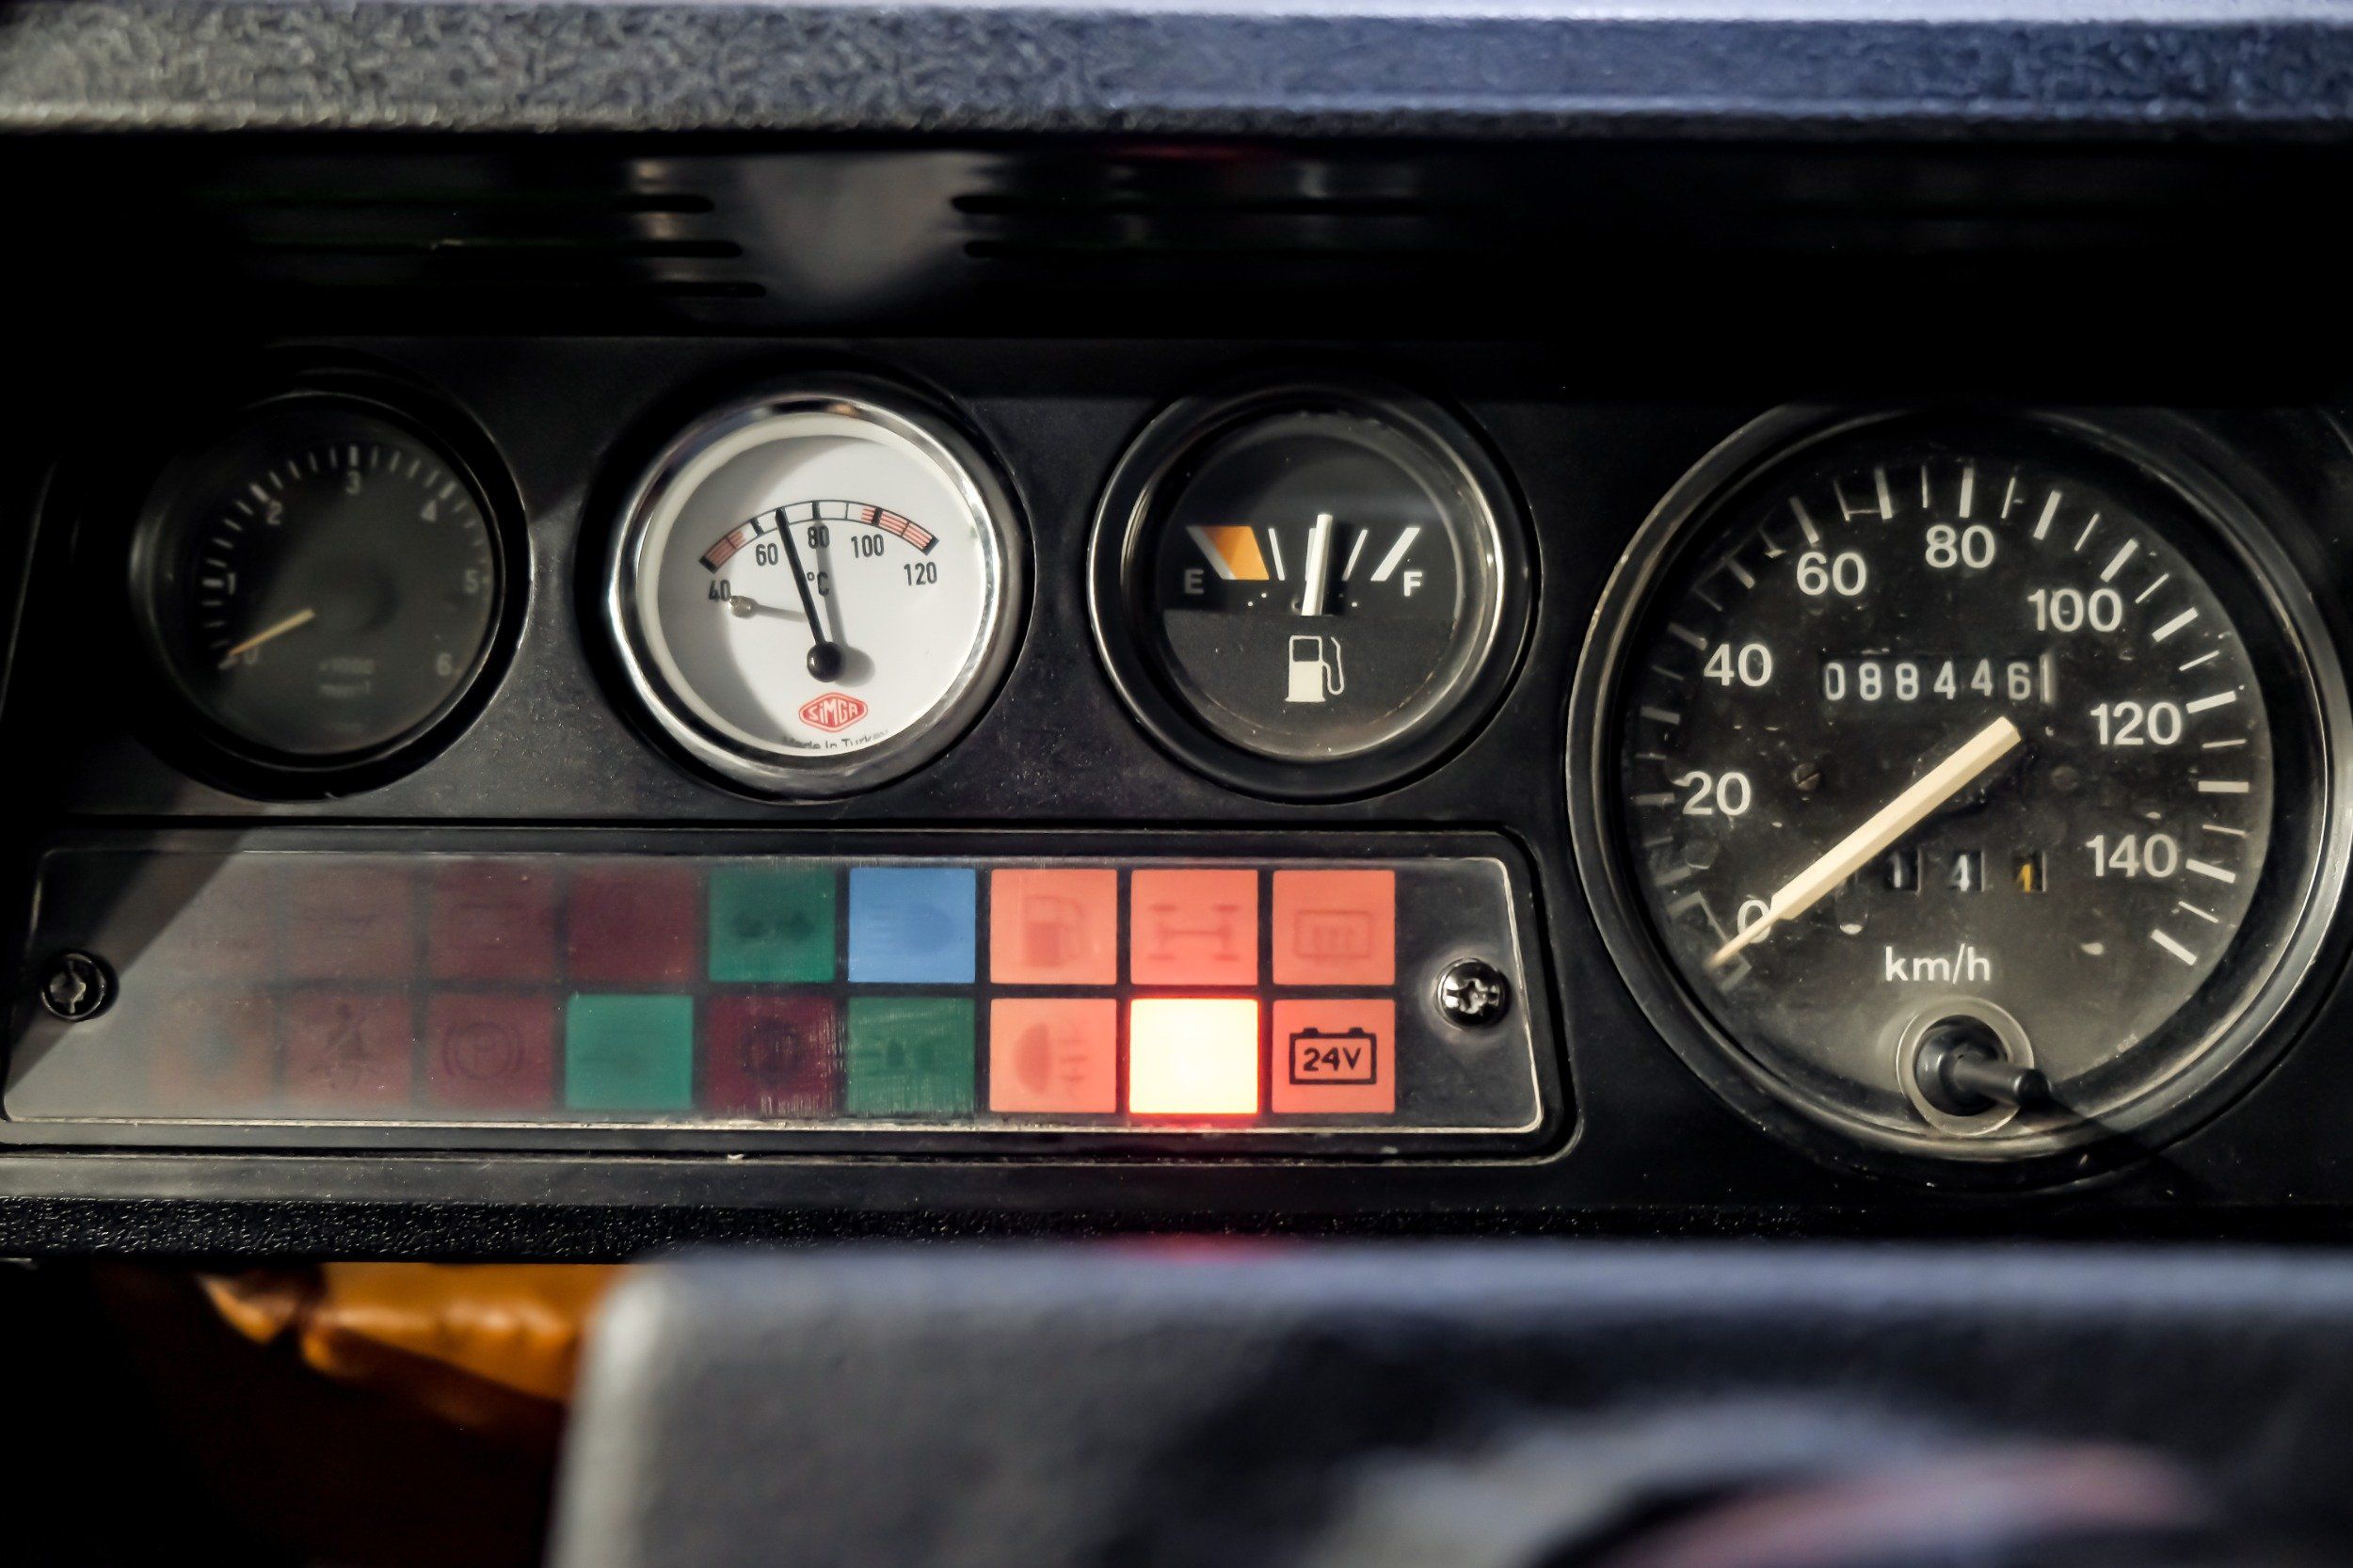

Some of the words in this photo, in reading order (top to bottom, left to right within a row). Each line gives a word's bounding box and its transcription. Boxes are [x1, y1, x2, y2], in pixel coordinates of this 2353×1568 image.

[344, 471, 361, 494] 3
[266, 501, 283, 526] 2
[421, 500, 438, 522] 4
[808, 525, 830, 550] 80
[851, 534, 884, 558] 100
[1925, 524, 1995, 568] 80
[755, 543, 779, 567] 60
[904, 561, 938, 585] 120
[1184, 568, 1205, 595] E
[1403, 571, 1423, 597] F
[1796, 552, 1866, 596] 60
[709, 579, 731, 602] 40
[2027, 588, 2122, 632] 100
[1703, 642, 1772, 686] 40
[2089, 701, 2182, 745] 120
[1683, 771, 1751, 816] 20
[2085, 834, 2178, 877] 140
[1737, 899, 1771, 943] 0
[1884, 943, 1991, 984] km/h
[1304, 1047, 1362, 1071] 24V
